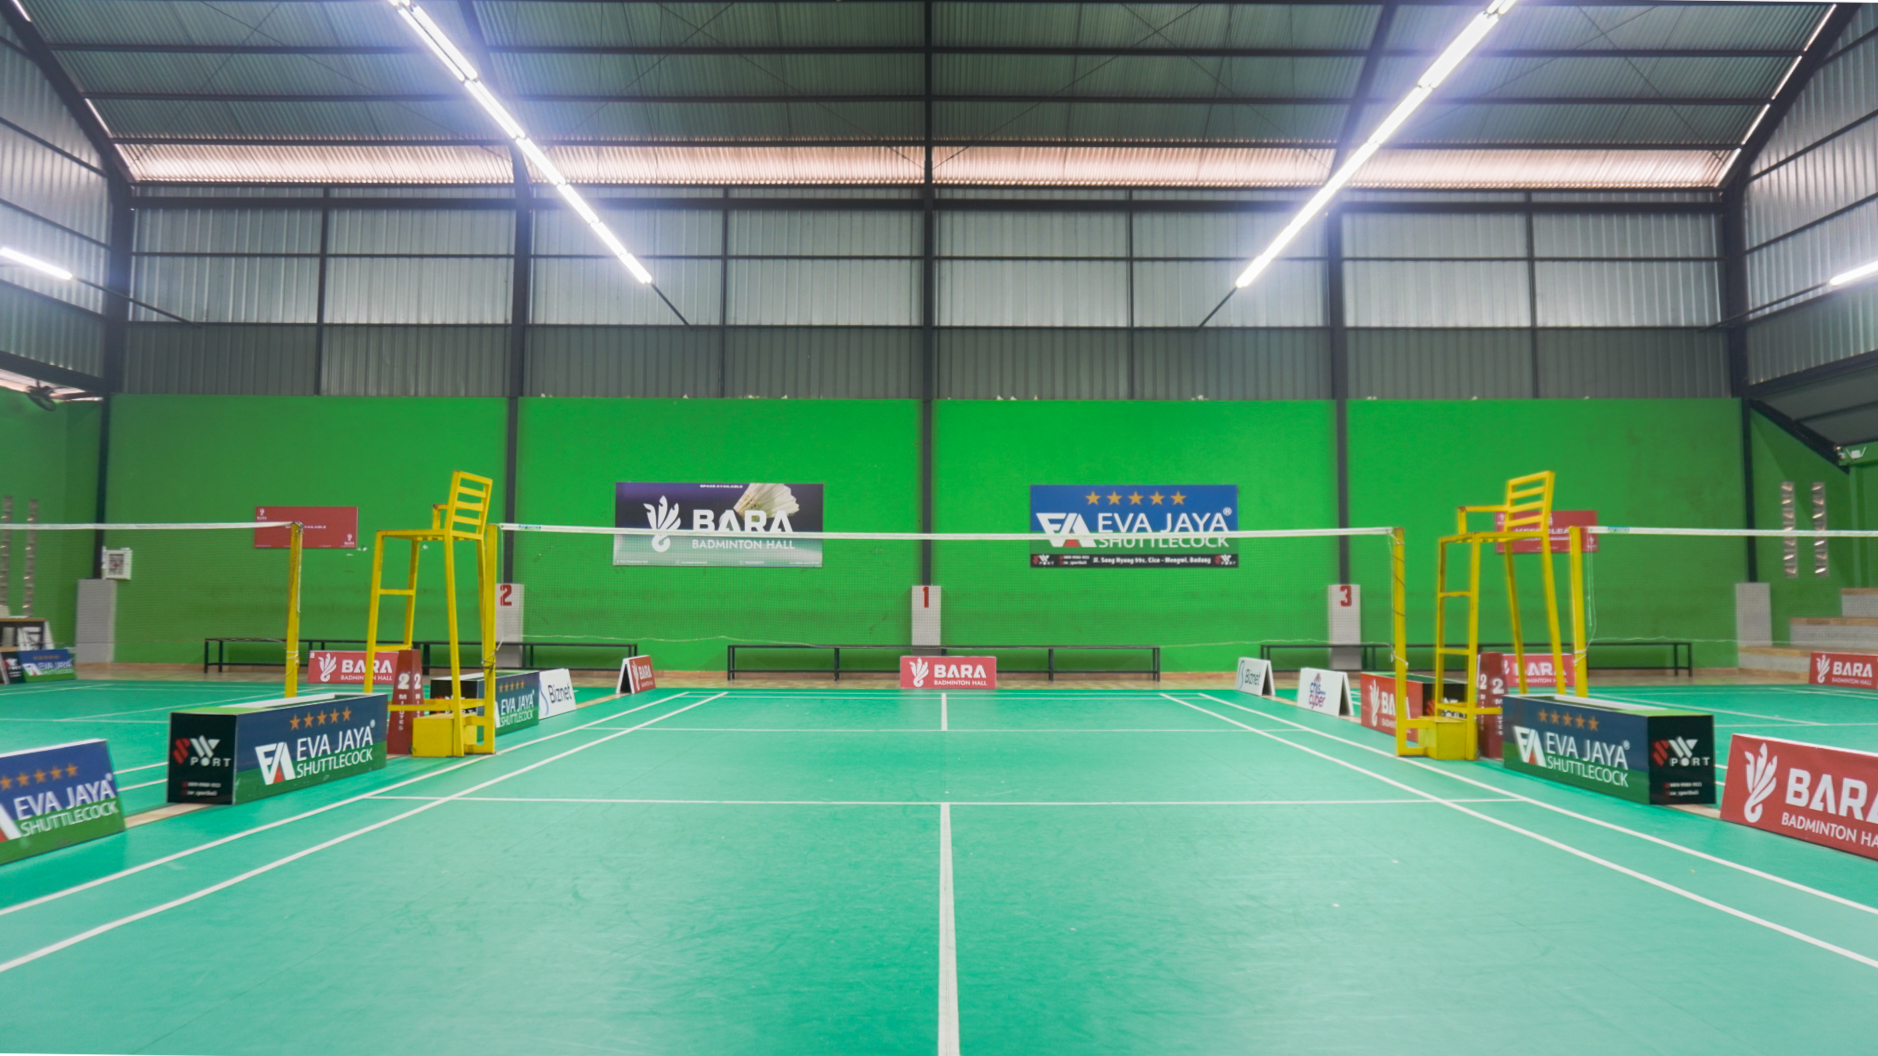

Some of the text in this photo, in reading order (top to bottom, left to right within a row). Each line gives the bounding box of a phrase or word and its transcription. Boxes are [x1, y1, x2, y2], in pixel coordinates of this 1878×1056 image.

[693, 509, 794, 533] BARA
[1098, 512, 1152, 533] EVA
[692, 539, 795, 550] BADMINTON HALL
[500, 584, 512, 606] 2
[922, 586, 929, 608] 1
[1340, 585, 1352, 607] 3
[342, 659, 393, 673] BARA
[934, 664, 987, 678] BARA
[1832, 661, 1873, 678] BARA
[398, 673, 410, 689] 2
[414, 673, 421, 689] 2
[1245, 668, 1261, 686] Biznet
[1480, 674, 1487, 690] 2
[1492, 678, 1505, 694] 2
[548, 684, 572, 703] Biznet
[500, 697, 516, 715] EVA
[296, 734, 331, 762] EVA
[1545, 731, 1579, 759] EVA
[296, 748, 373, 778] SHUTTLECOCK
[1546, 756, 1629, 788] SHUTTLECOCK
[14, 791, 63, 820] EVA
[20, 801, 119, 837] SHUTTLECOCK
[1781, 812, 1878, 848] BADMINTON HA
